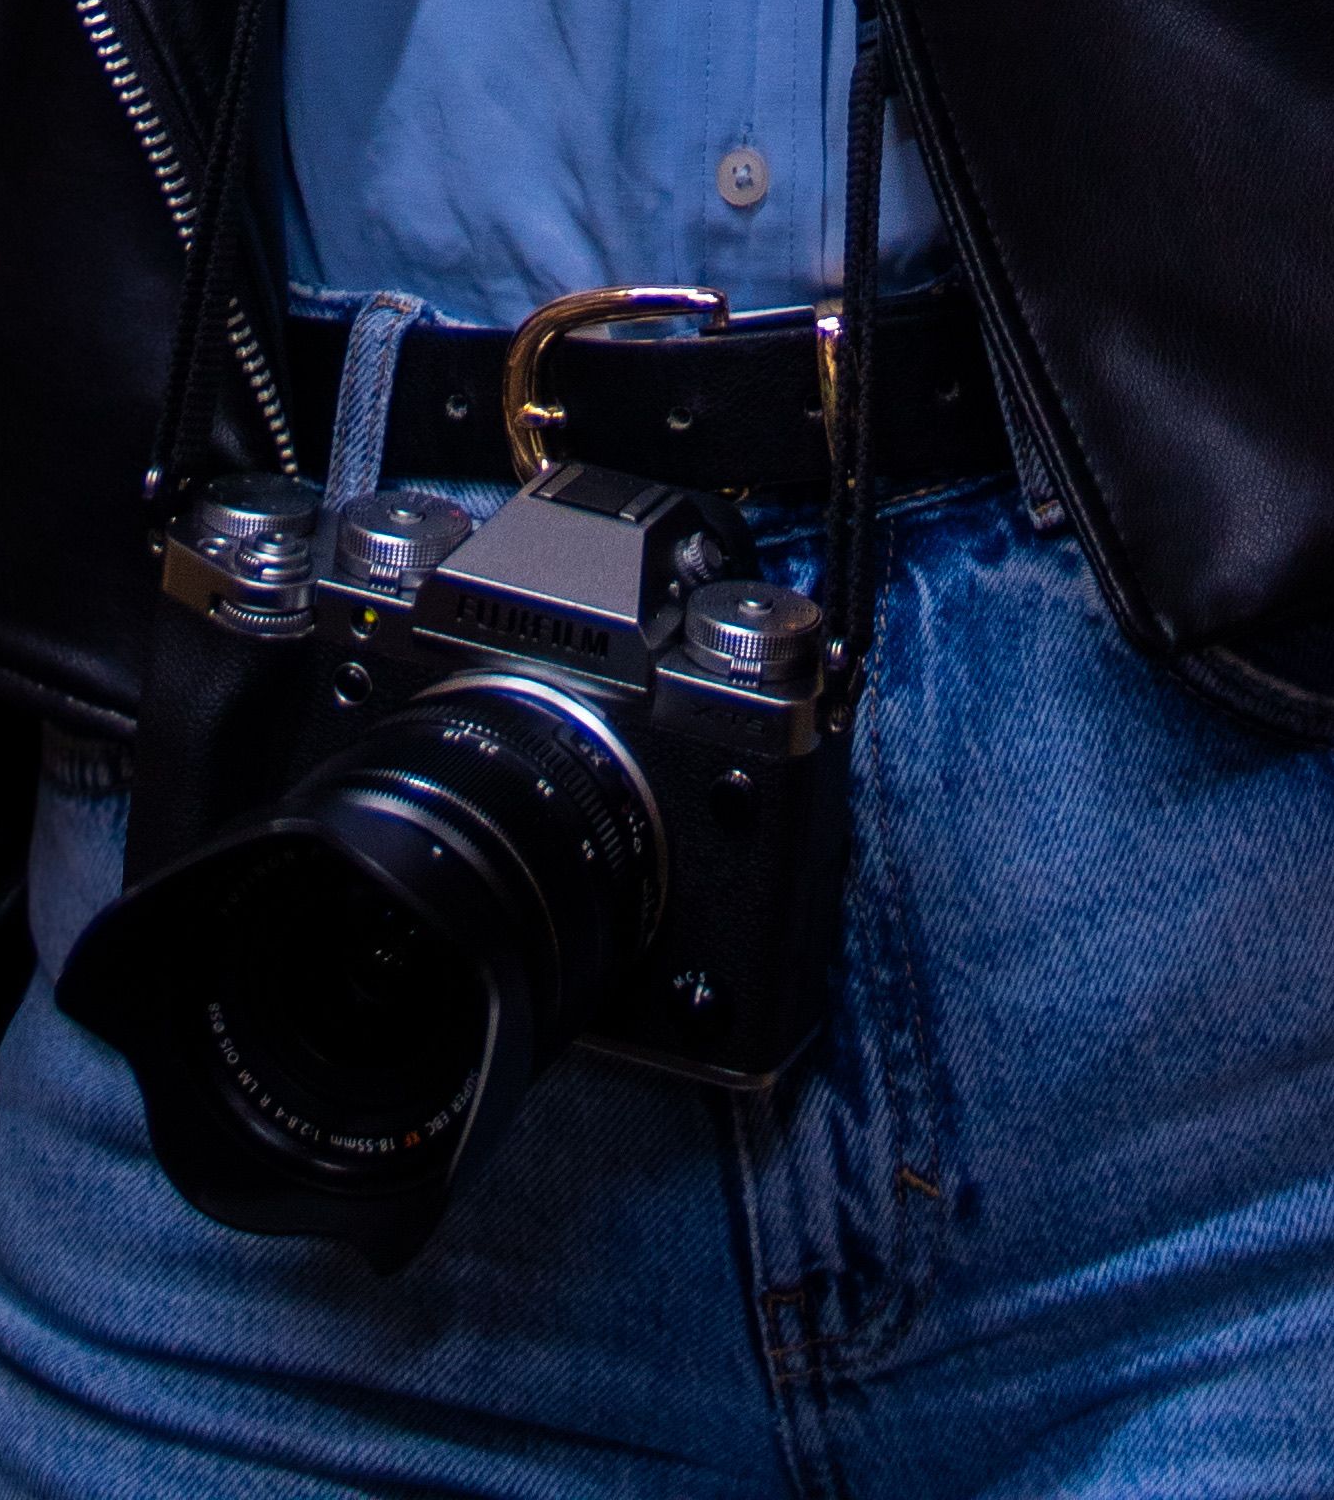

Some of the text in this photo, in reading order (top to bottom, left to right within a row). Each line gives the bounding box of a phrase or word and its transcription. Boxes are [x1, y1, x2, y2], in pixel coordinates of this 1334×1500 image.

[455, 593, 611, 661] FUJIFILM
[217, 1036, 241, 1066] OIS
[236, 1068, 259, 1093] LM
